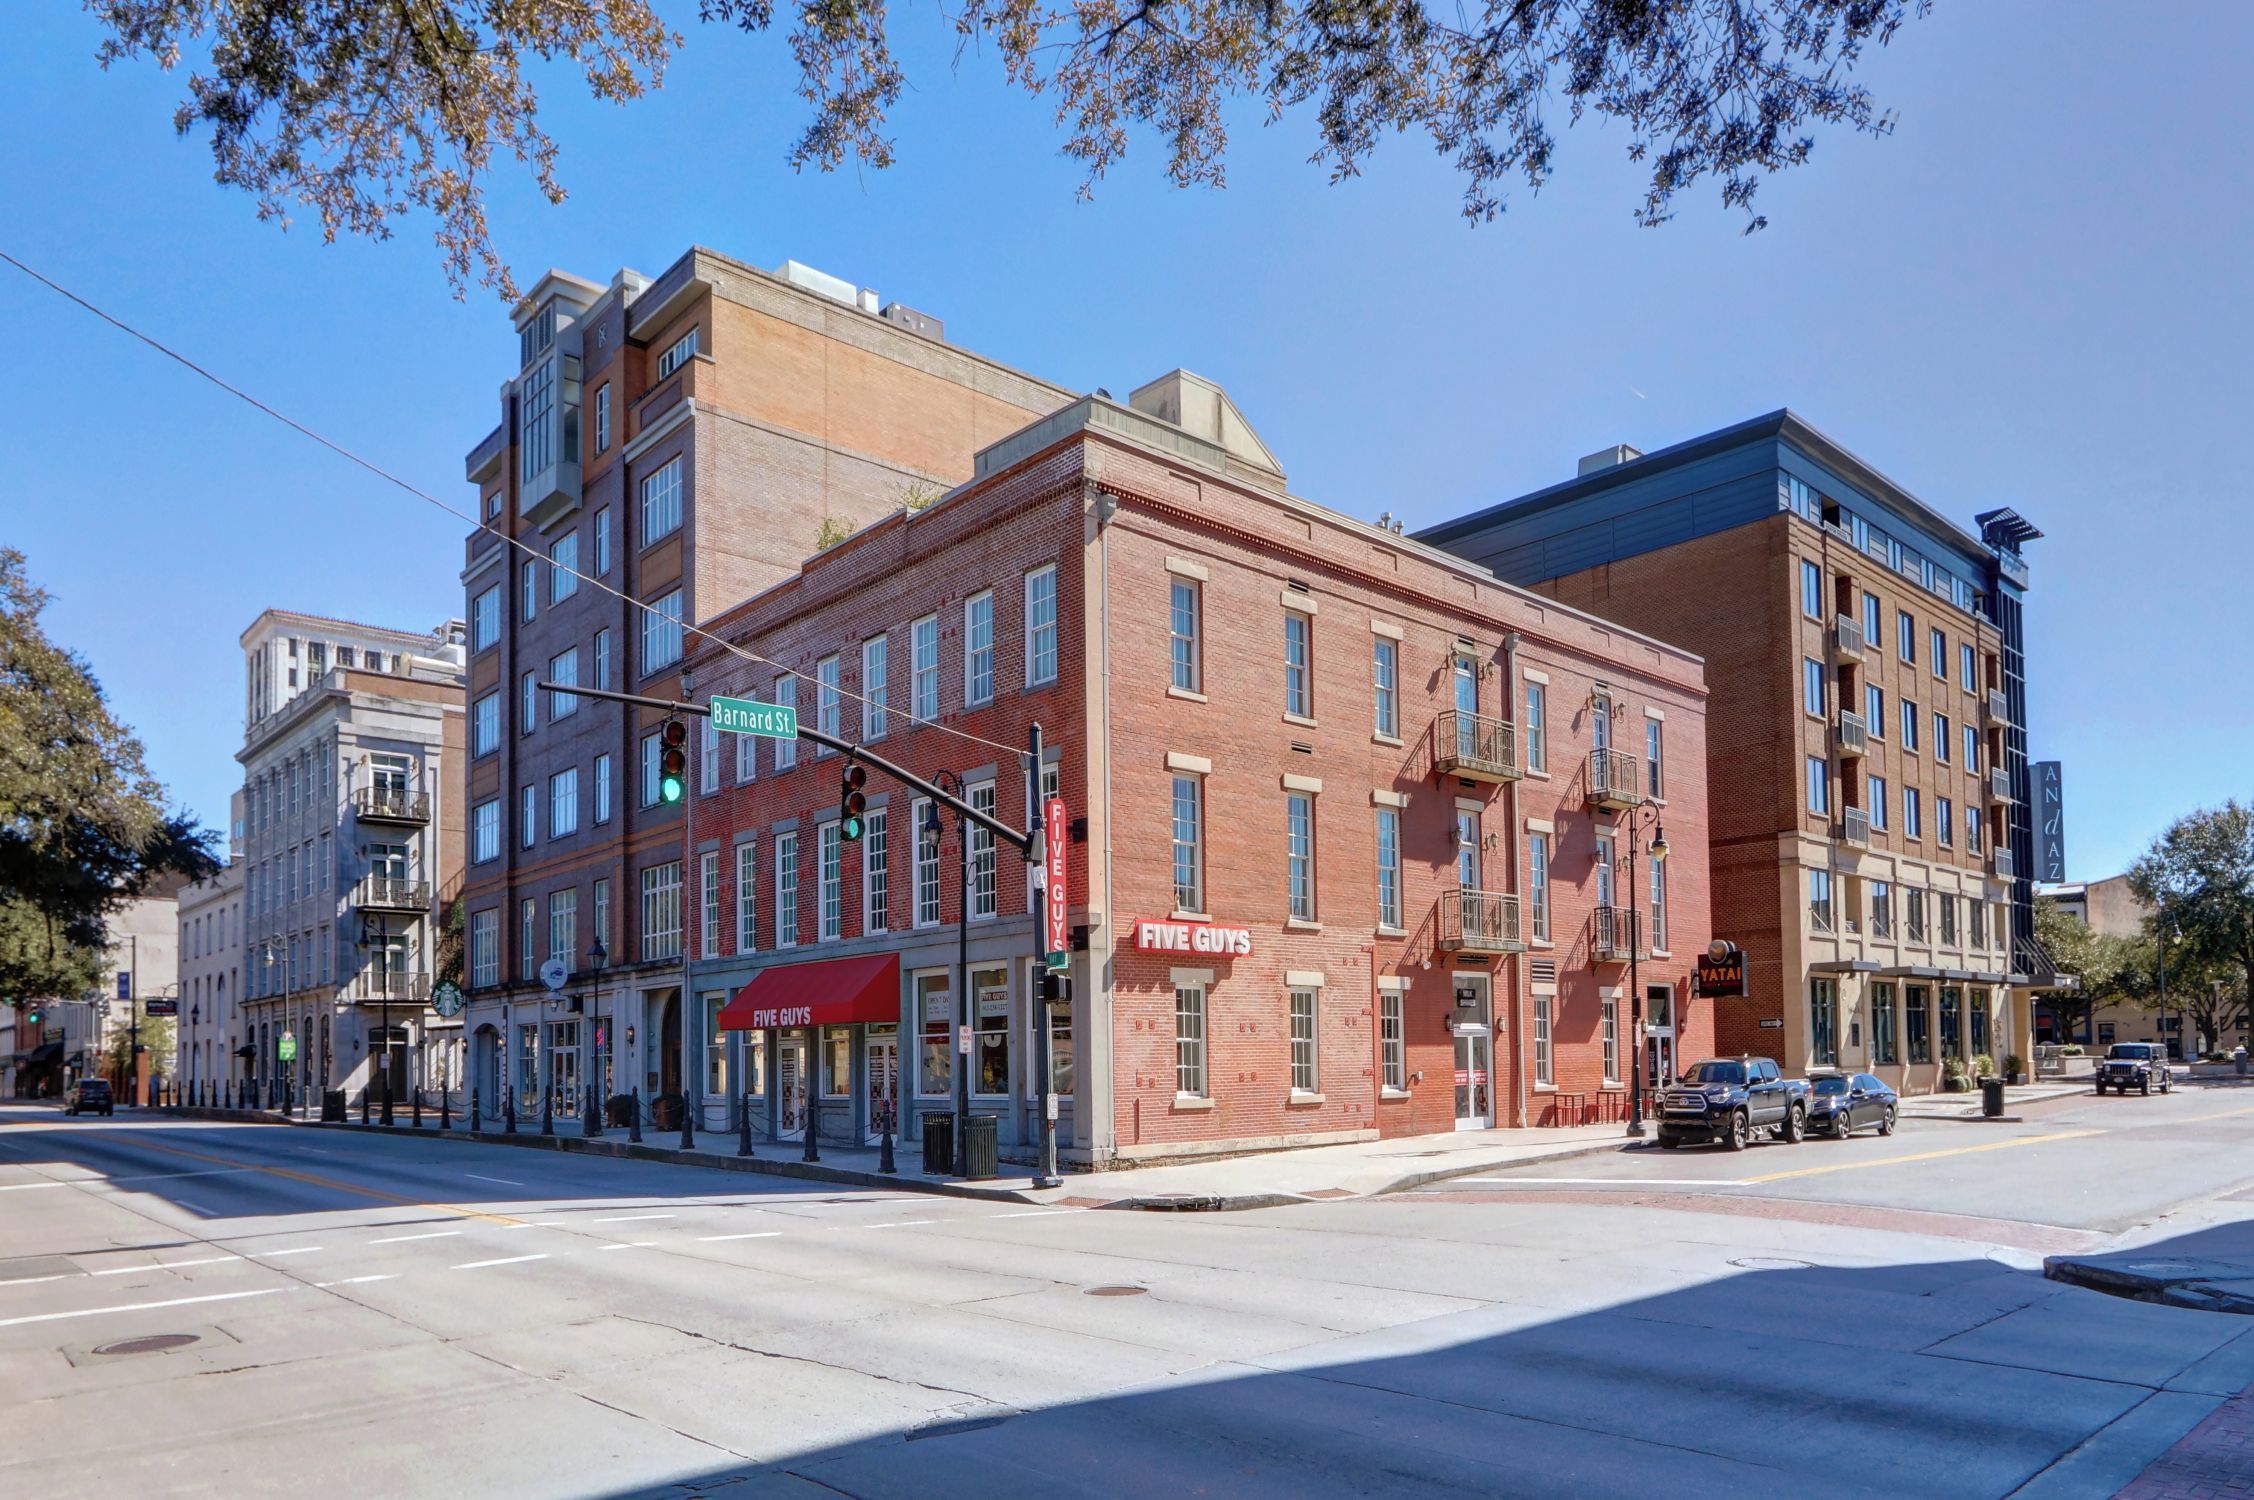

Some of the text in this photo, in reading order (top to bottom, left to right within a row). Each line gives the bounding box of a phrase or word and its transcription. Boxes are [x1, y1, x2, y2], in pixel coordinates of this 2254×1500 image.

[713, 701, 794, 734] Barnard St.
[1052, 804, 1063, 876] FIVE
[1052, 884, 1064, 952] GUYS
[1139, 922, 1251, 954] FIVE GUYS
[1700, 967, 1741, 982] YATAI
[753, 1006, 811, 1027] FIVE GUYS
